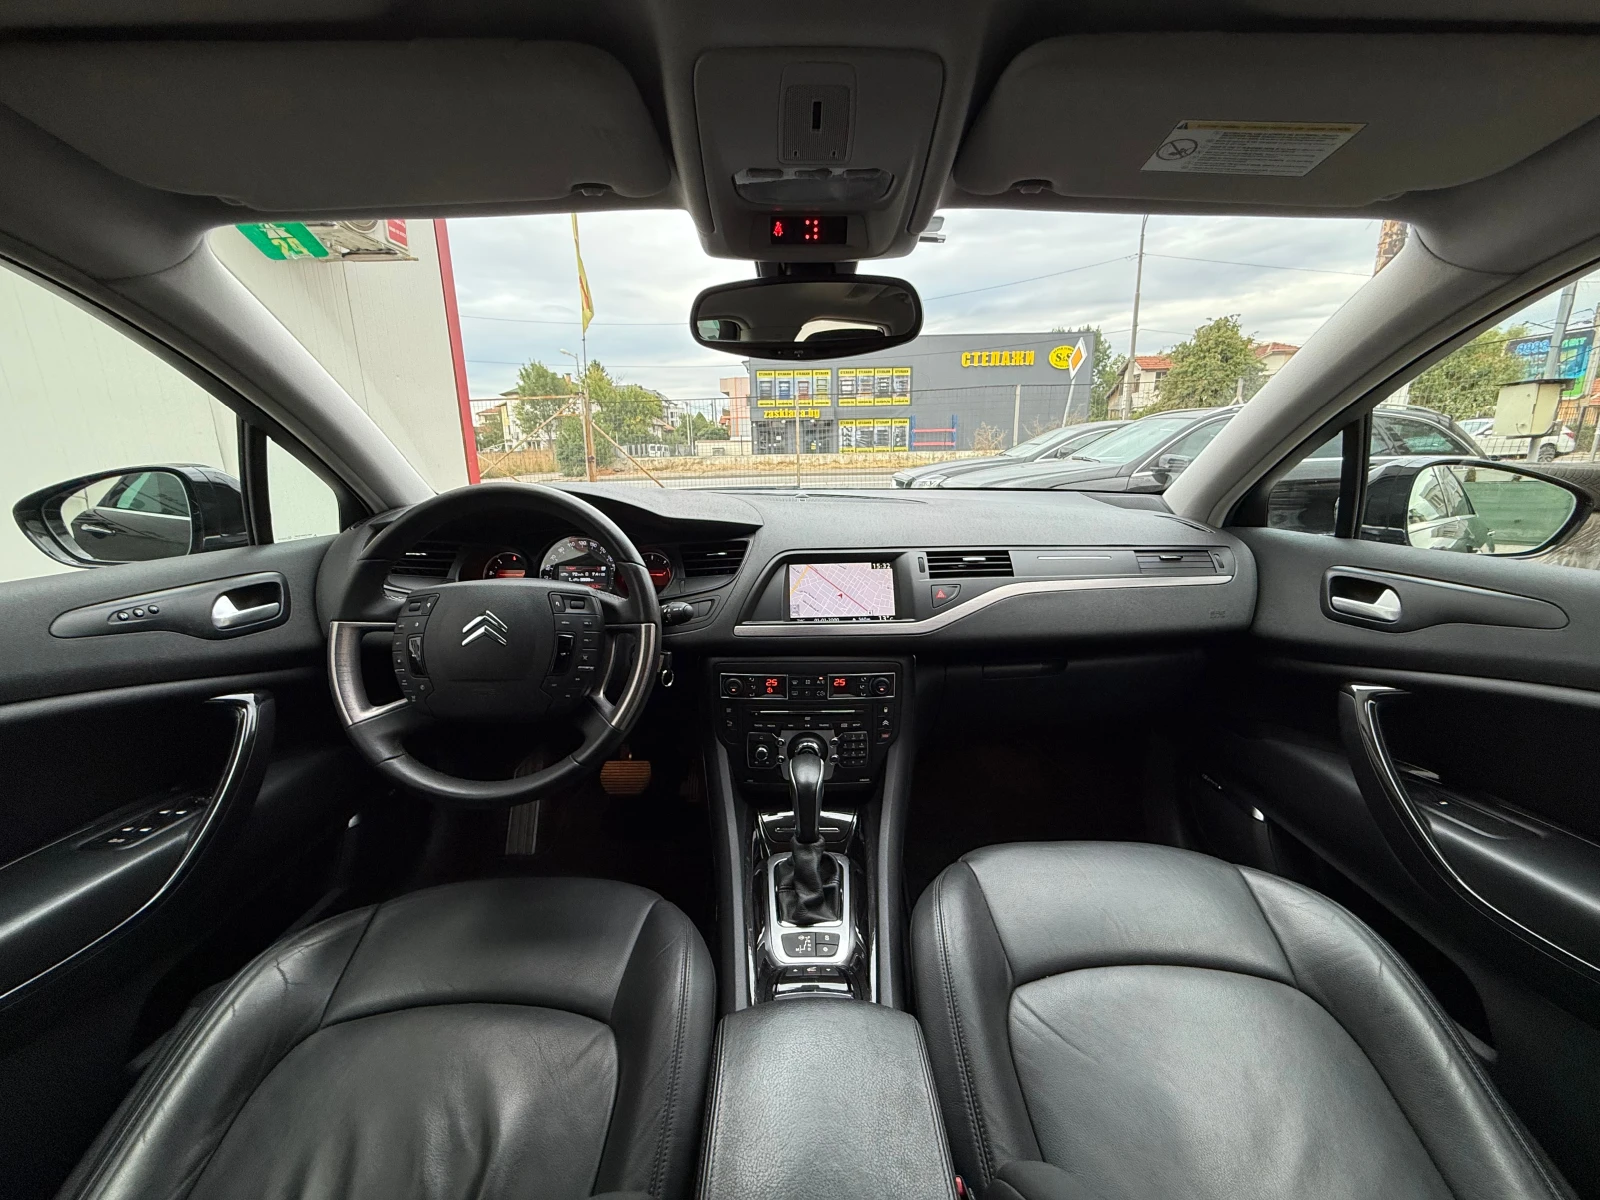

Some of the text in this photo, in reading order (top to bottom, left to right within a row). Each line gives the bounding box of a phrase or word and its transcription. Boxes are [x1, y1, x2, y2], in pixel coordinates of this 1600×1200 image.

[961, 350, 1034, 367] СТЕЛАЖИ
[763, 408, 820, 418] zasklaa.bg
[765, 678, 778, 687] 25
[833, 678, 846, 687] 25
